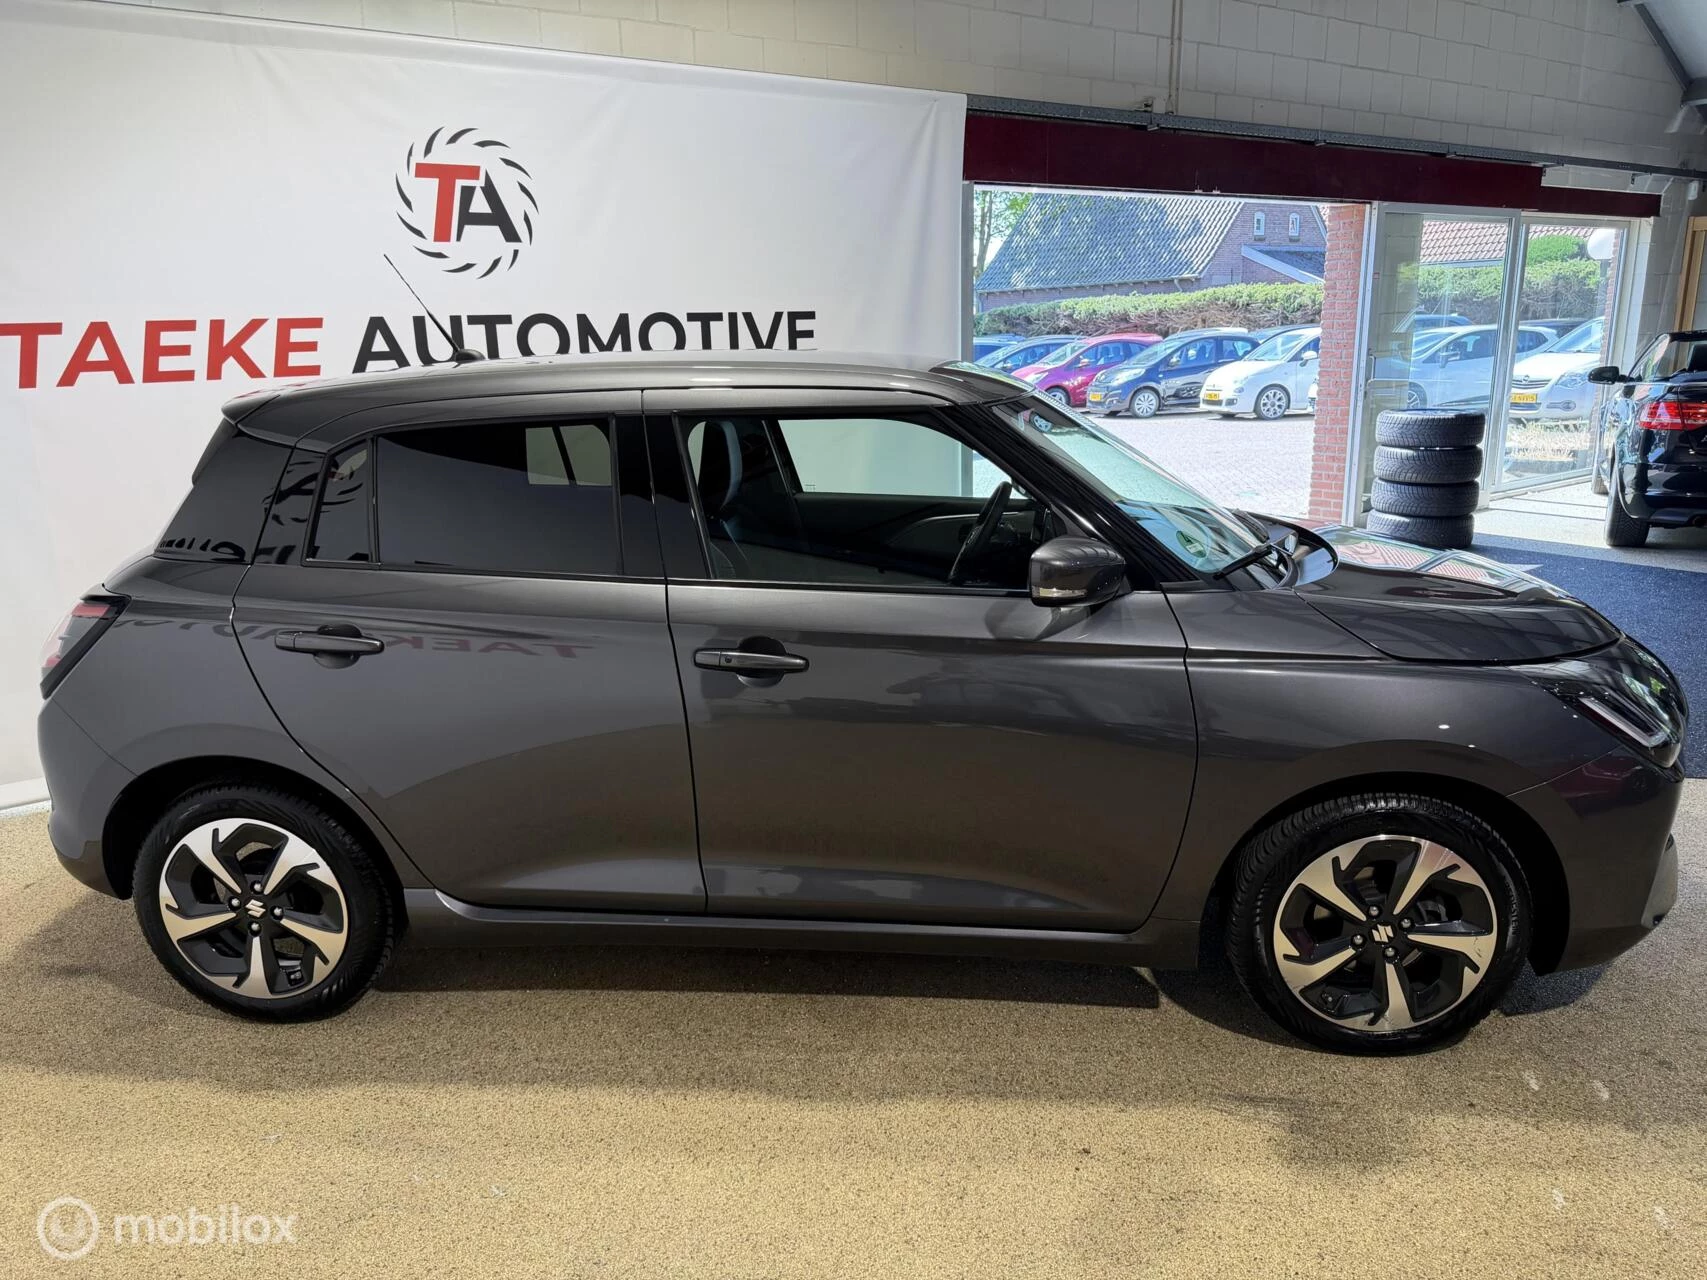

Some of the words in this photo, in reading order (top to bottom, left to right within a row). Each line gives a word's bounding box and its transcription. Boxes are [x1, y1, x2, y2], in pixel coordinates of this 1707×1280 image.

[414, 162, 523, 243] TA
[0, 317, 324, 389] TAEKE
[352, 311, 816, 374] AUTOMOTIVE
